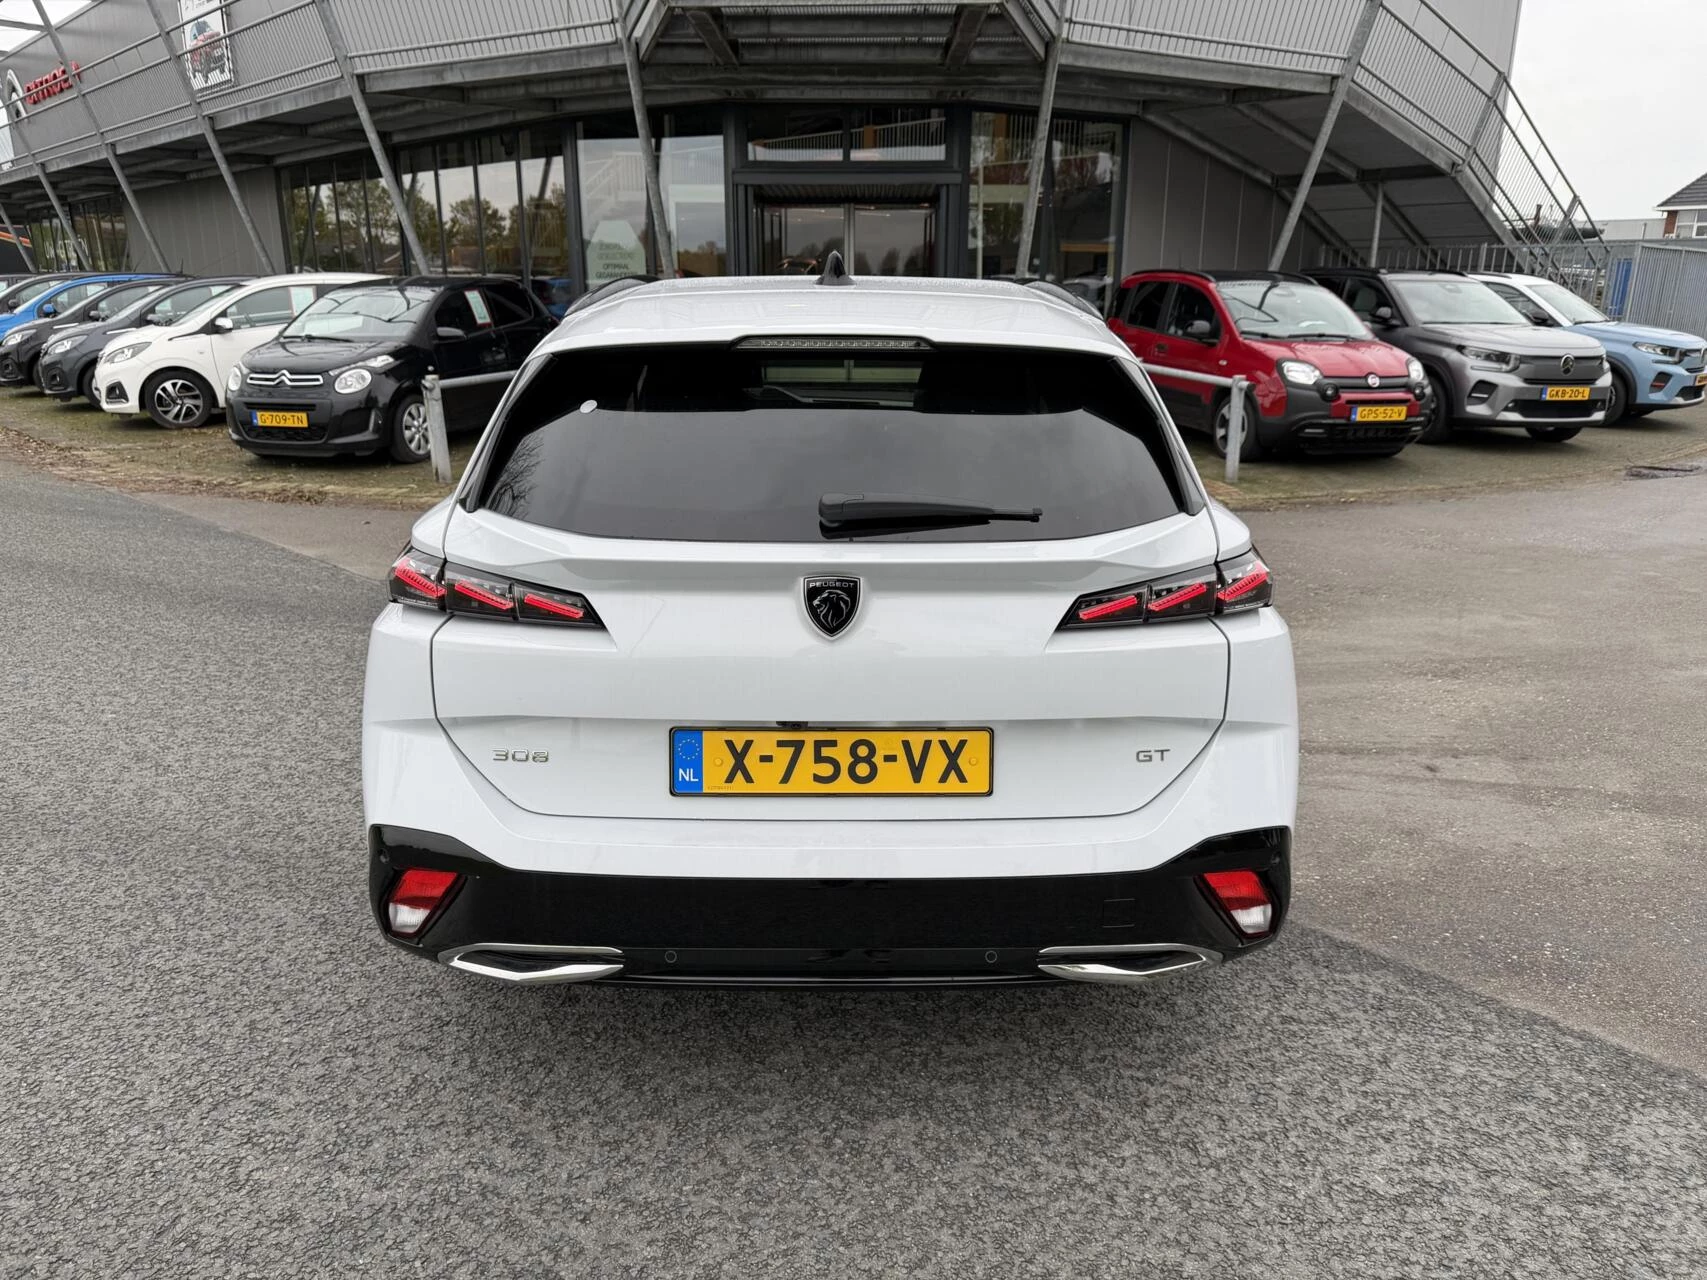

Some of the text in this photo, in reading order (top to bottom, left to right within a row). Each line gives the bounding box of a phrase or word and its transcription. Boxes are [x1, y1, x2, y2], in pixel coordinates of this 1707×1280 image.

[1549, 388, 1587, 399] GKB-20-L
[260, 413, 304, 425] G-709-TN
[1360, 408, 1404, 419] GPS-52-V
[491, 748, 549, 763] 308
[724, 738, 969, 785] X-758-VX
[1136, 749, 1171, 762] GT
[678, 768, 699, 782] NL
